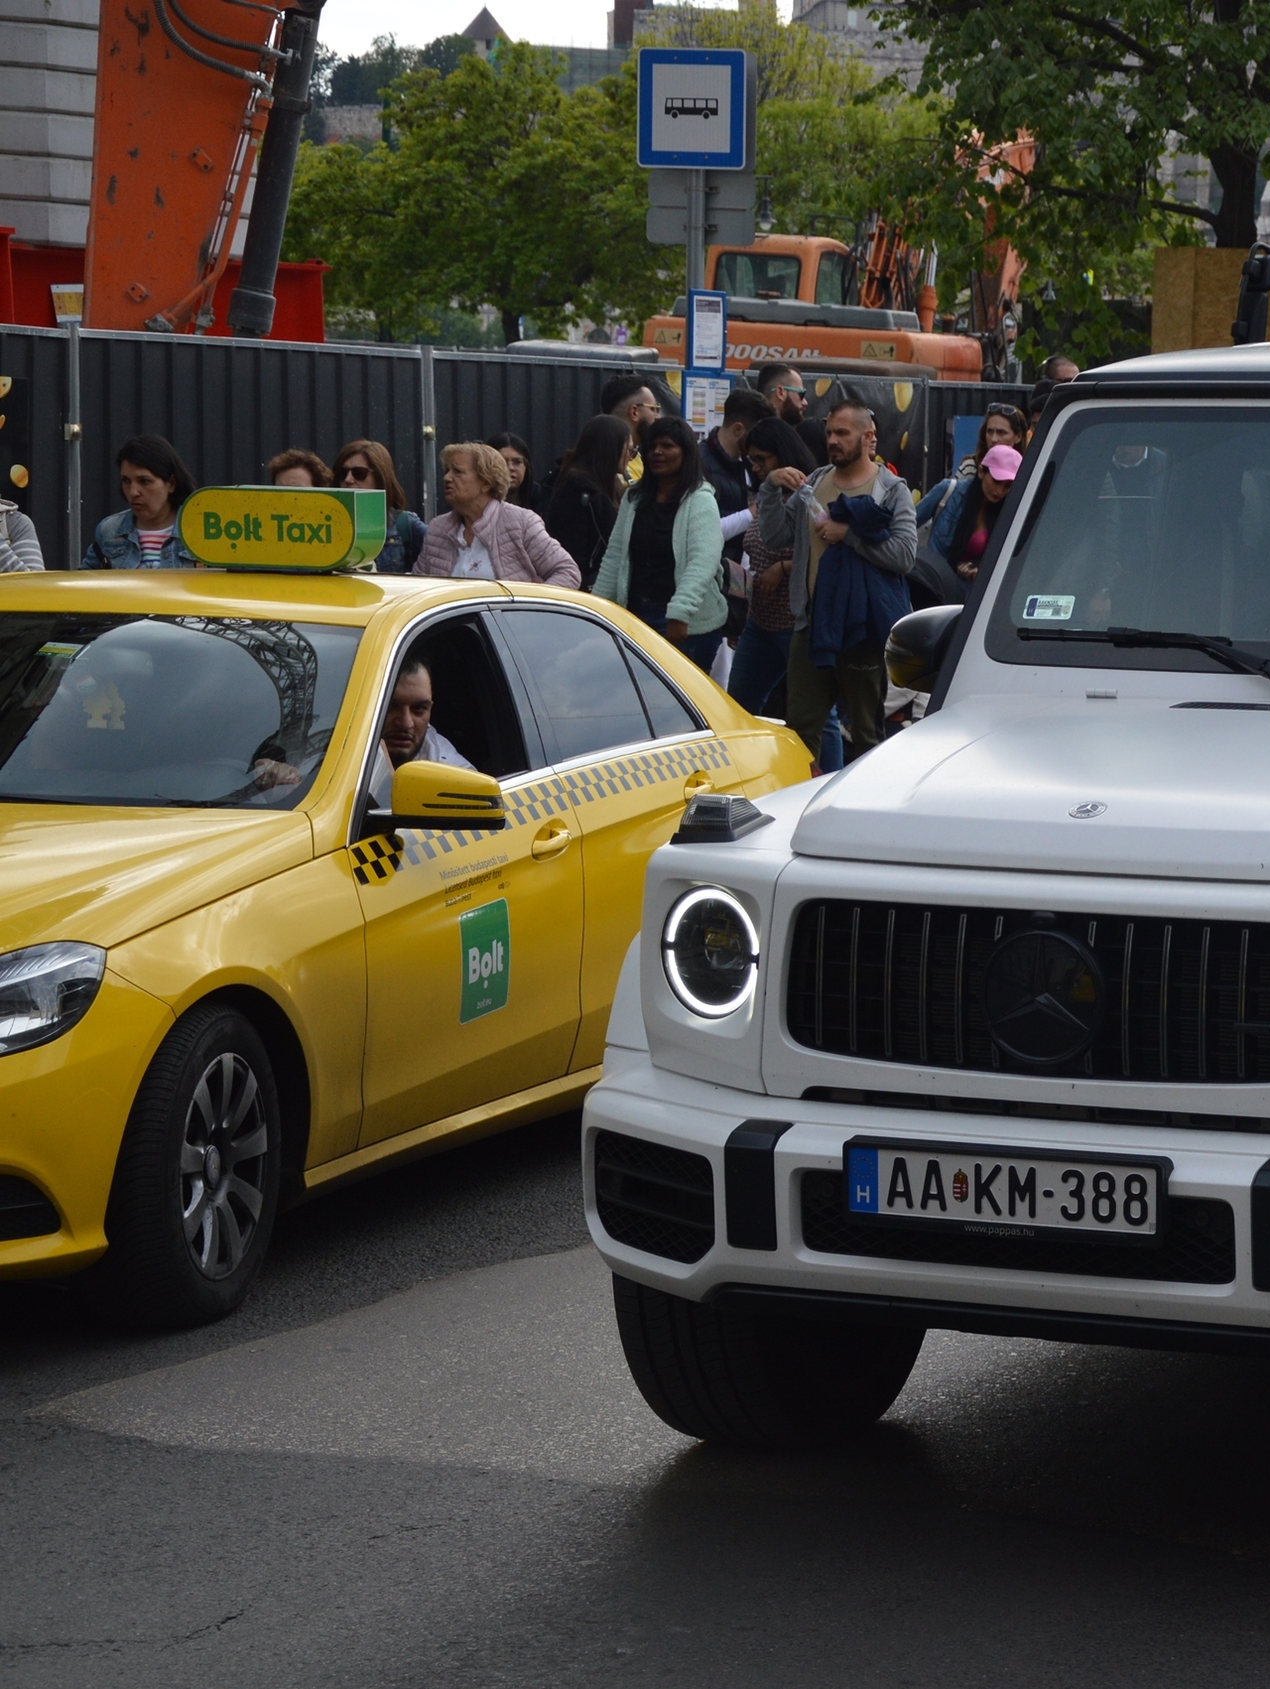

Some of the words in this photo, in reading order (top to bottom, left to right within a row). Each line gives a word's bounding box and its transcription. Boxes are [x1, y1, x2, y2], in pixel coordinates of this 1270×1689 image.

[203, 511, 263, 550] Bolt
[270, 514, 333, 545] Taxi
[469, 855, 499, 871] budapesti
[497, 852, 509, 864] taxi
[468, 939, 504, 989] Bolt
[856, 1184, 871, 1204] H
[886, 1156, 947, 1211] AA
[973, 1161, 1149, 1226] KM-388
[963, 1224, 1035, 1237] www.pappas.hu
